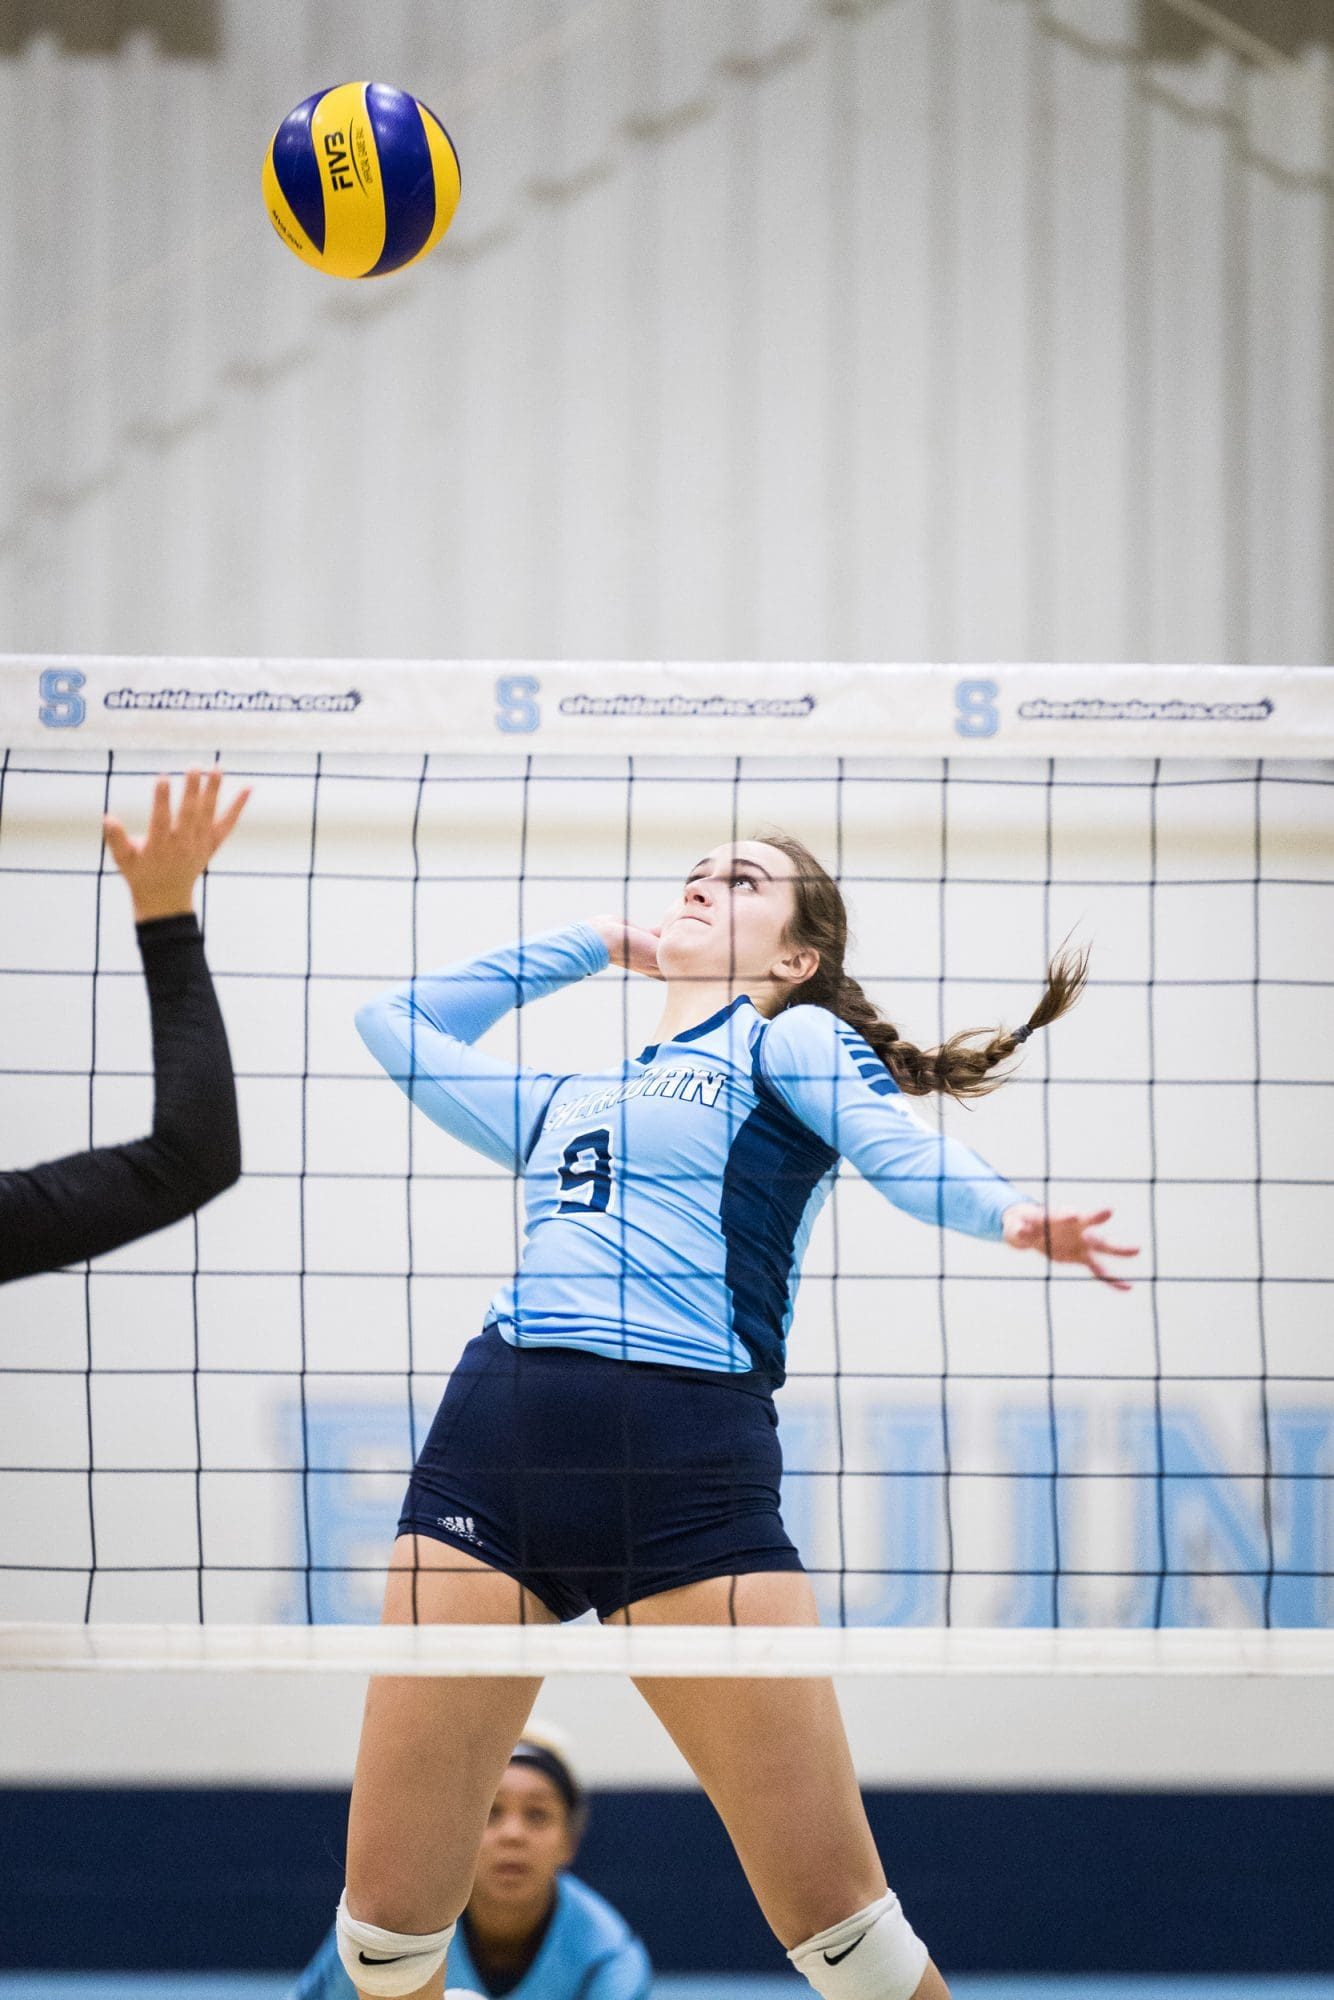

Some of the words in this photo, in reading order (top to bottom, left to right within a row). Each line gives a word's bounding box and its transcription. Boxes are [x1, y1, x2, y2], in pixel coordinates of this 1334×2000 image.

[324, 130, 353, 192] FIVB
[39, 667, 86, 728] S
[103, 688, 354, 712] sheridanbruins.com
[496, 676, 540, 733] S
[954, 680, 999, 737] S
[555, 1127, 614, 1216] 9
